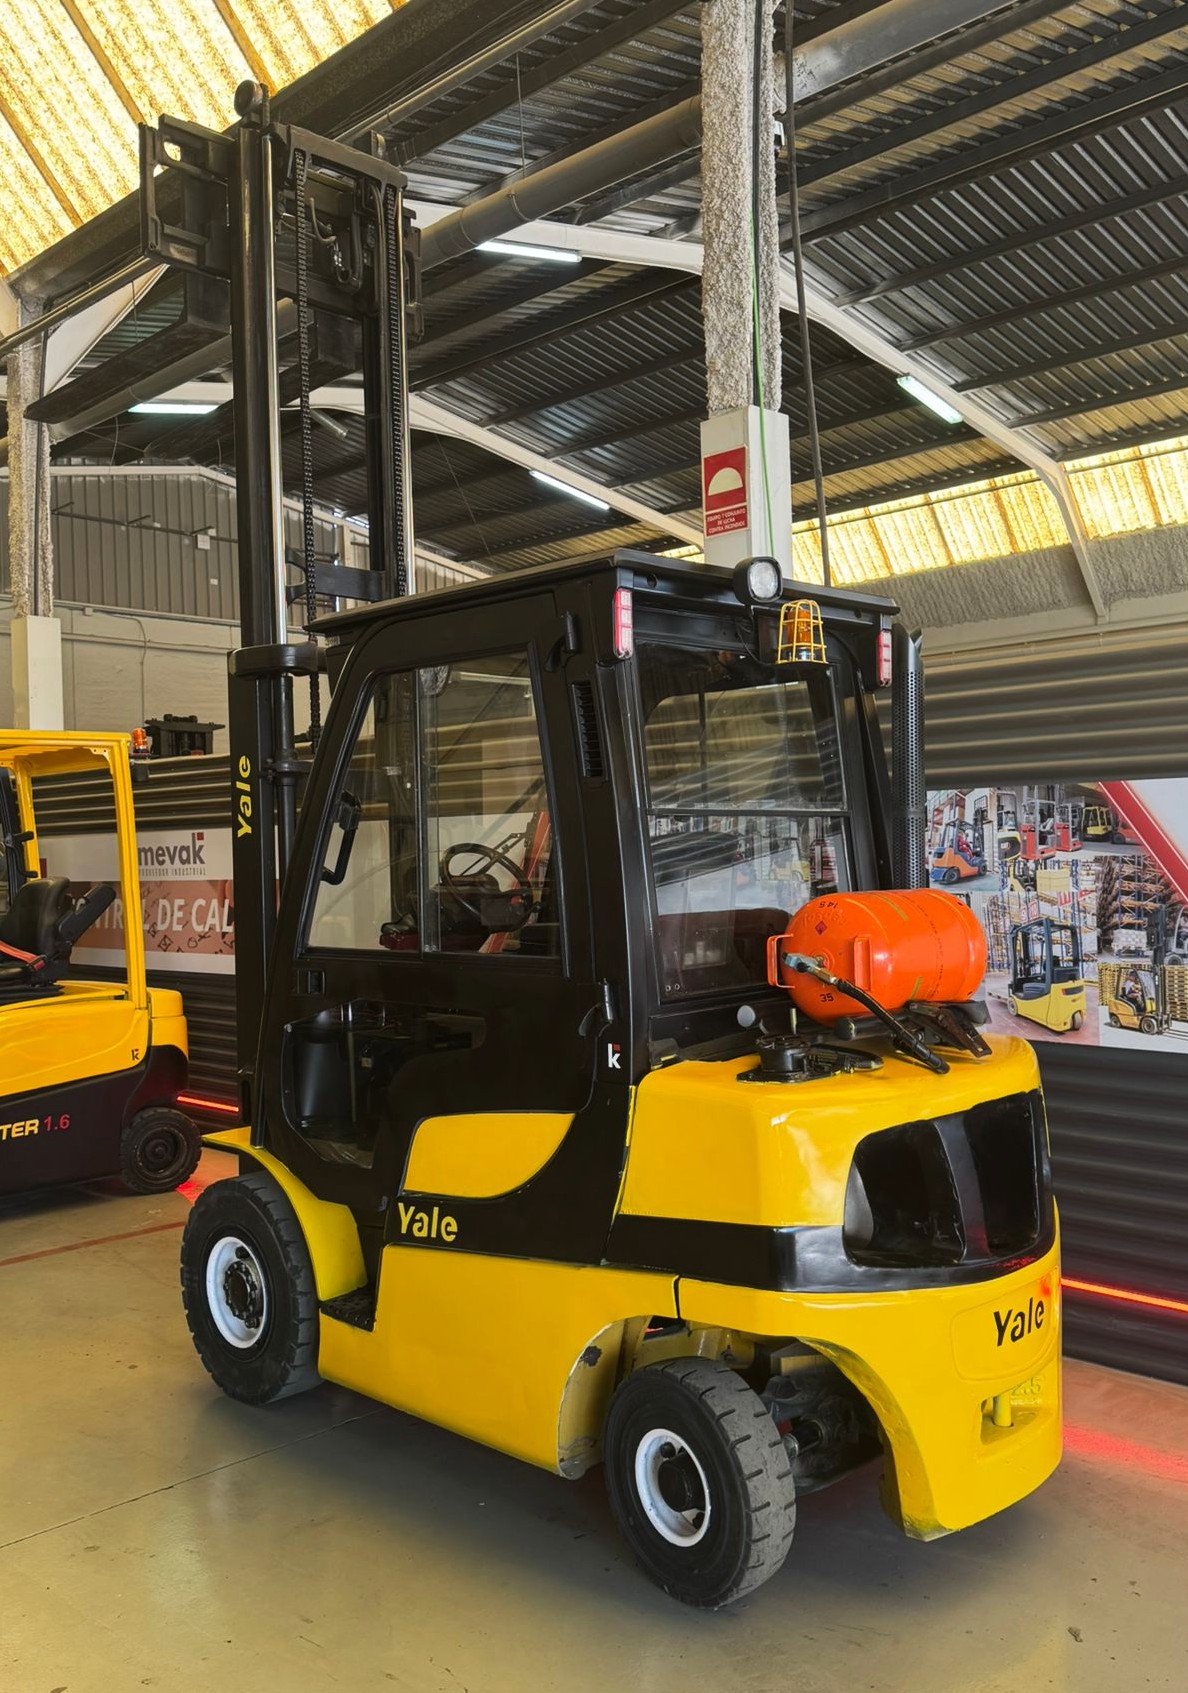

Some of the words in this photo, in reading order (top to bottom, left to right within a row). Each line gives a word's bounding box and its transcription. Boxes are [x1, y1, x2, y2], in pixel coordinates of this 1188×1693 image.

[236, 755, 252, 838] Yale
[157, 898, 185, 931] DE
[820, 993, 834, 1003] 35
[0, 1119, 40, 1140] TER
[44, 1114, 70, 1131] 1.6
[398, 1202, 458, 1242] Yale
[993, 1297, 1045, 1347] Yale
